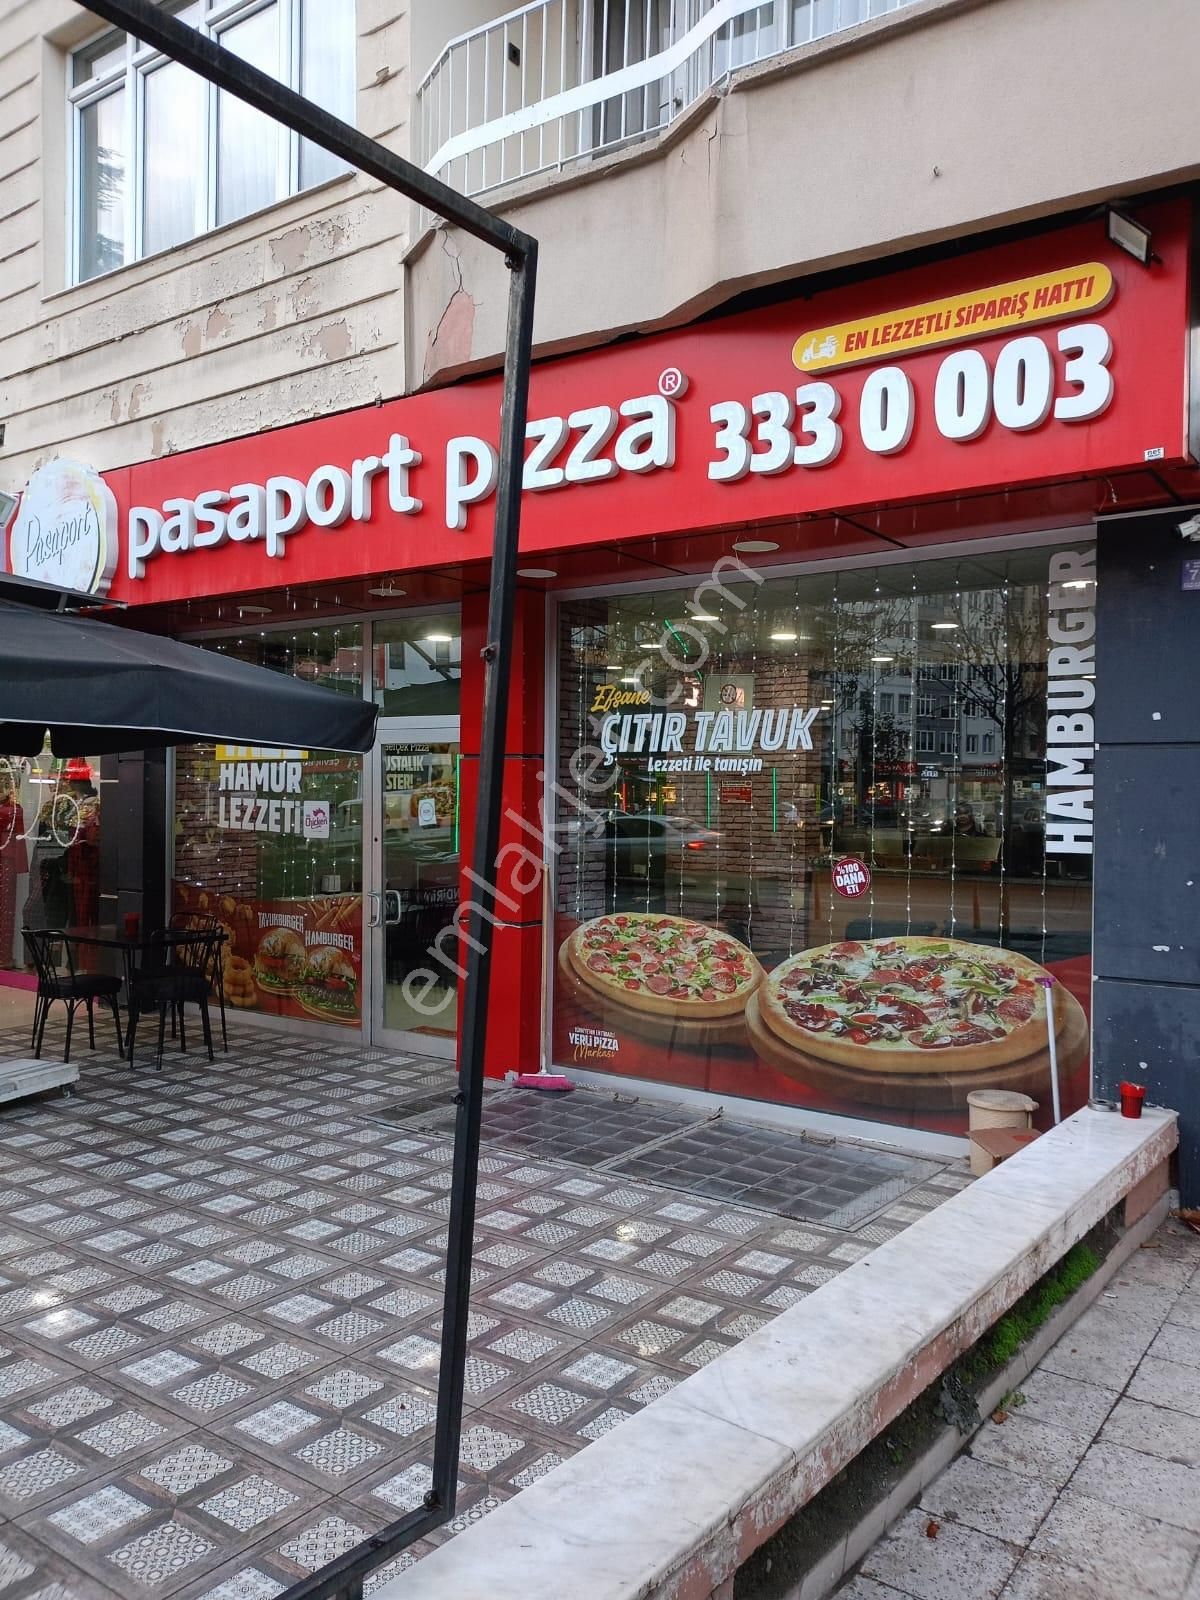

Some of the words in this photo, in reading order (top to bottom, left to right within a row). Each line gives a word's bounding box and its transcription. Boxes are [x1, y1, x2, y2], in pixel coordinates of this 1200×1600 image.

[844, 334, 868, 353] EN
[1033, 276, 1095, 309] HATTI
[708, 381, 843, 482] 333
[859, 366, 915, 455] 0
[934, 323, 1114, 441] 003
[127, 433, 422, 580] pasaport
[446, 394, 676, 531] pzza
[26, 501, 92, 573] Pasaport
[590, 683, 651, 712] Efsane
[1045, 548, 1097, 855] HAMBURGER
[600, 712, 687, 766] ÇITIR
[694, 707, 820, 753] TAVUK
[219, 762, 303, 794] HAMUR
[647, 756, 693, 773] Lezzeti
[694, 755, 711, 772] ile
[385, 773, 414, 790] STER!
[836, 871, 865, 887] DANA
[837, 862, 859, 874] %100
[305, 930, 354, 952] HAMBURGER
